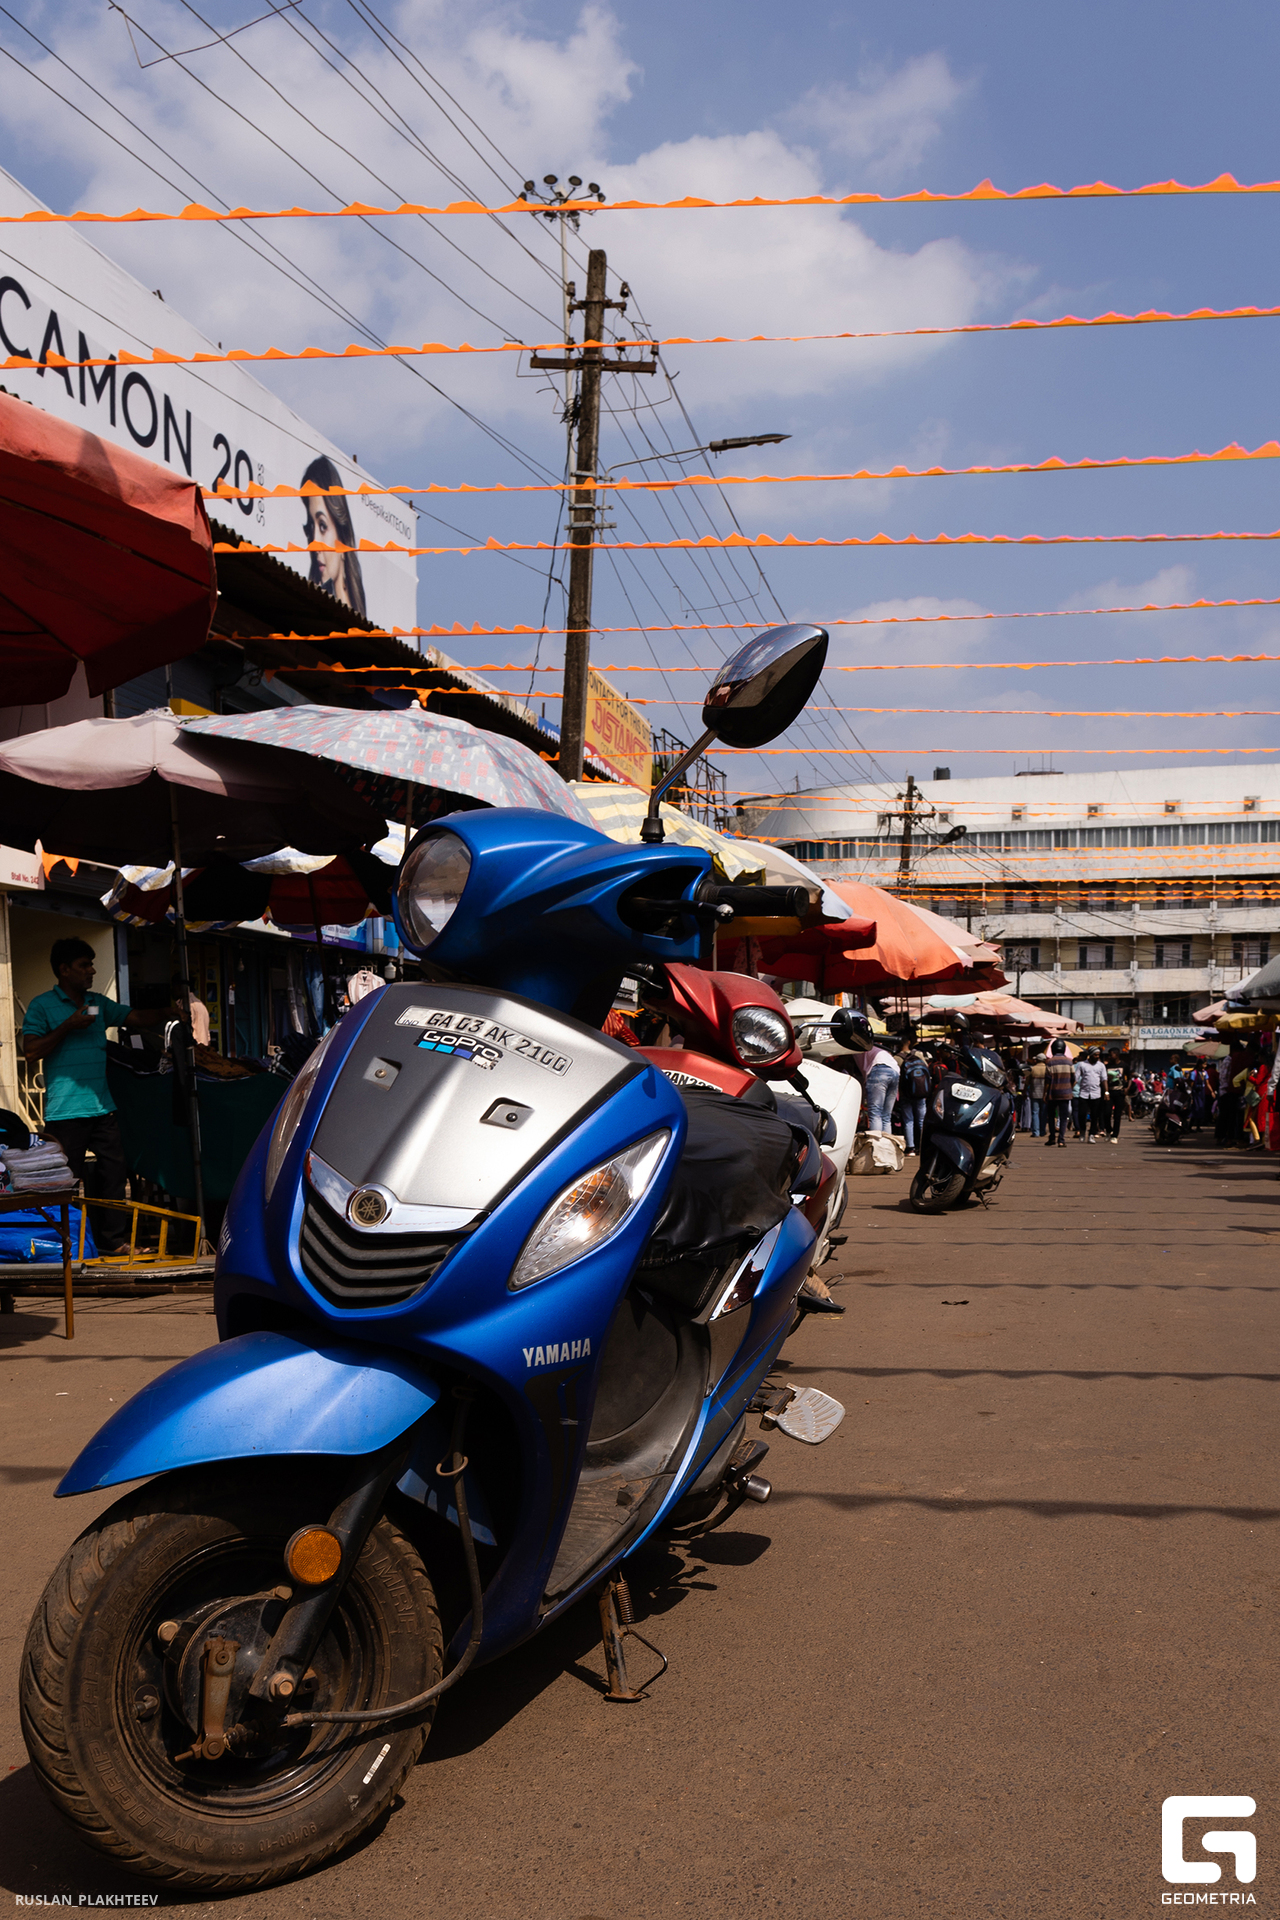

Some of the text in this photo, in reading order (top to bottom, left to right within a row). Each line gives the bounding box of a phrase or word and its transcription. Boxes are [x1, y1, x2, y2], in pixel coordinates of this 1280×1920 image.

[0, 276, 254, 516] CAMON 20
[587, 671, 615, 709] ONTACT
[422, 1030, 500, 1061] GoPro
[426, 1012, 454, 1029] GA
[484, 1026, 516, 1046] AK
[522, 1338, 591, 1368] YAMAHA
[371, 1556, 418, 1635] MRF
[88, 1739, 215, 1855] NYLOGRIP
